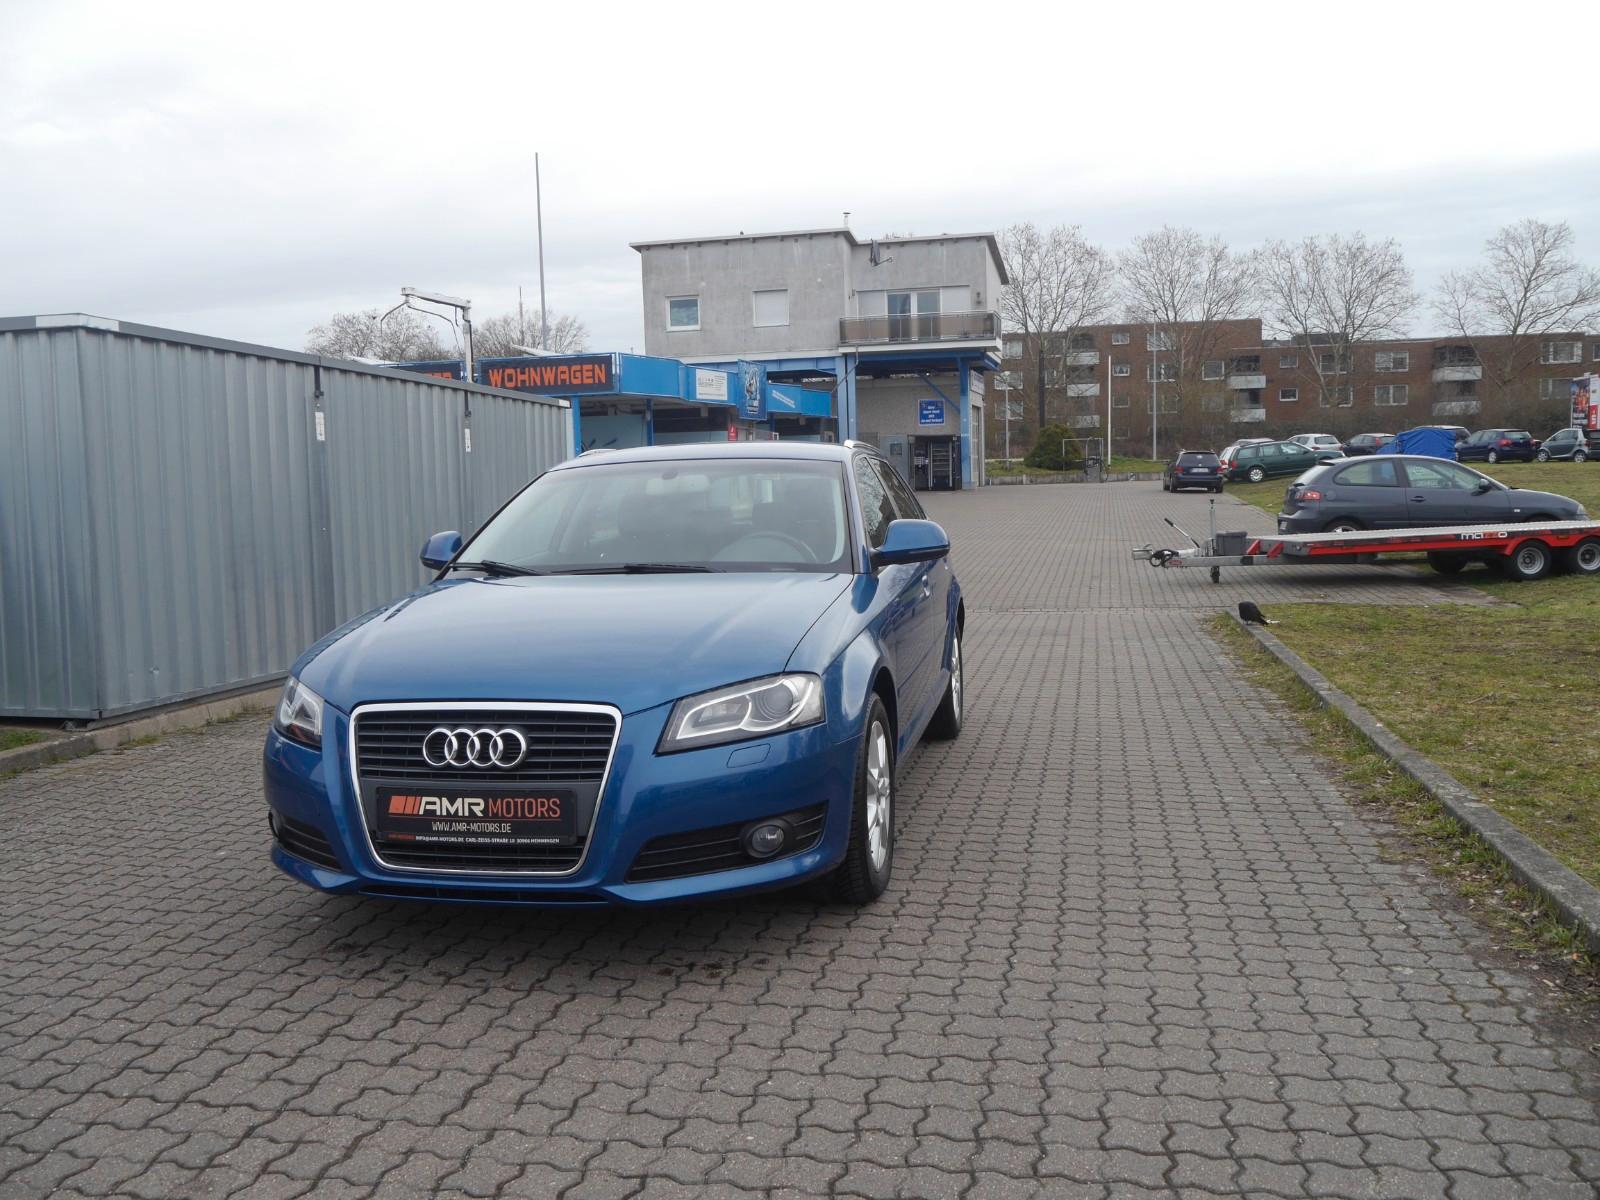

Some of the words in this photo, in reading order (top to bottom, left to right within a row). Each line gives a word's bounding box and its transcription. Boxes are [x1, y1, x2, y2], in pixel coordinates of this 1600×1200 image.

[488, 363, 606, 388] WOHNWAGEN
[418, 796, 485, 817] AMR
[488, 798, 561, 818] MOTORS
[431, 821, 512, 833] WWW.AMR-MOTORS.DE
